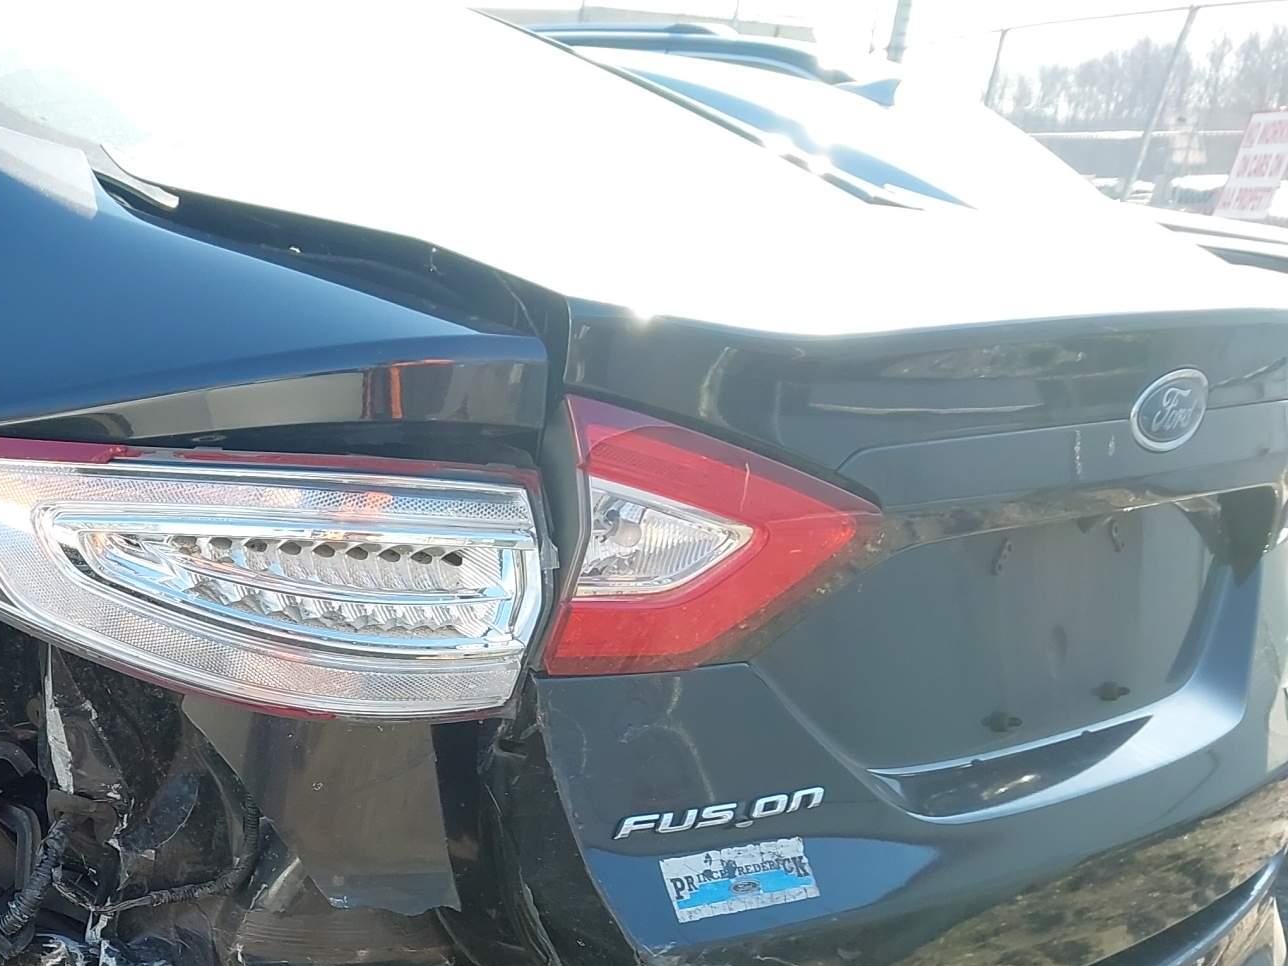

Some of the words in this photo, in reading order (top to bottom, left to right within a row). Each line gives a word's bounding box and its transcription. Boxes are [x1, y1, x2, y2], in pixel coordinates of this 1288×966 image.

[1151, 387, 1197, 433] Ford
[613, 786, 824, 840] FUSON
[729, 855, 810, 879] REDERICK
